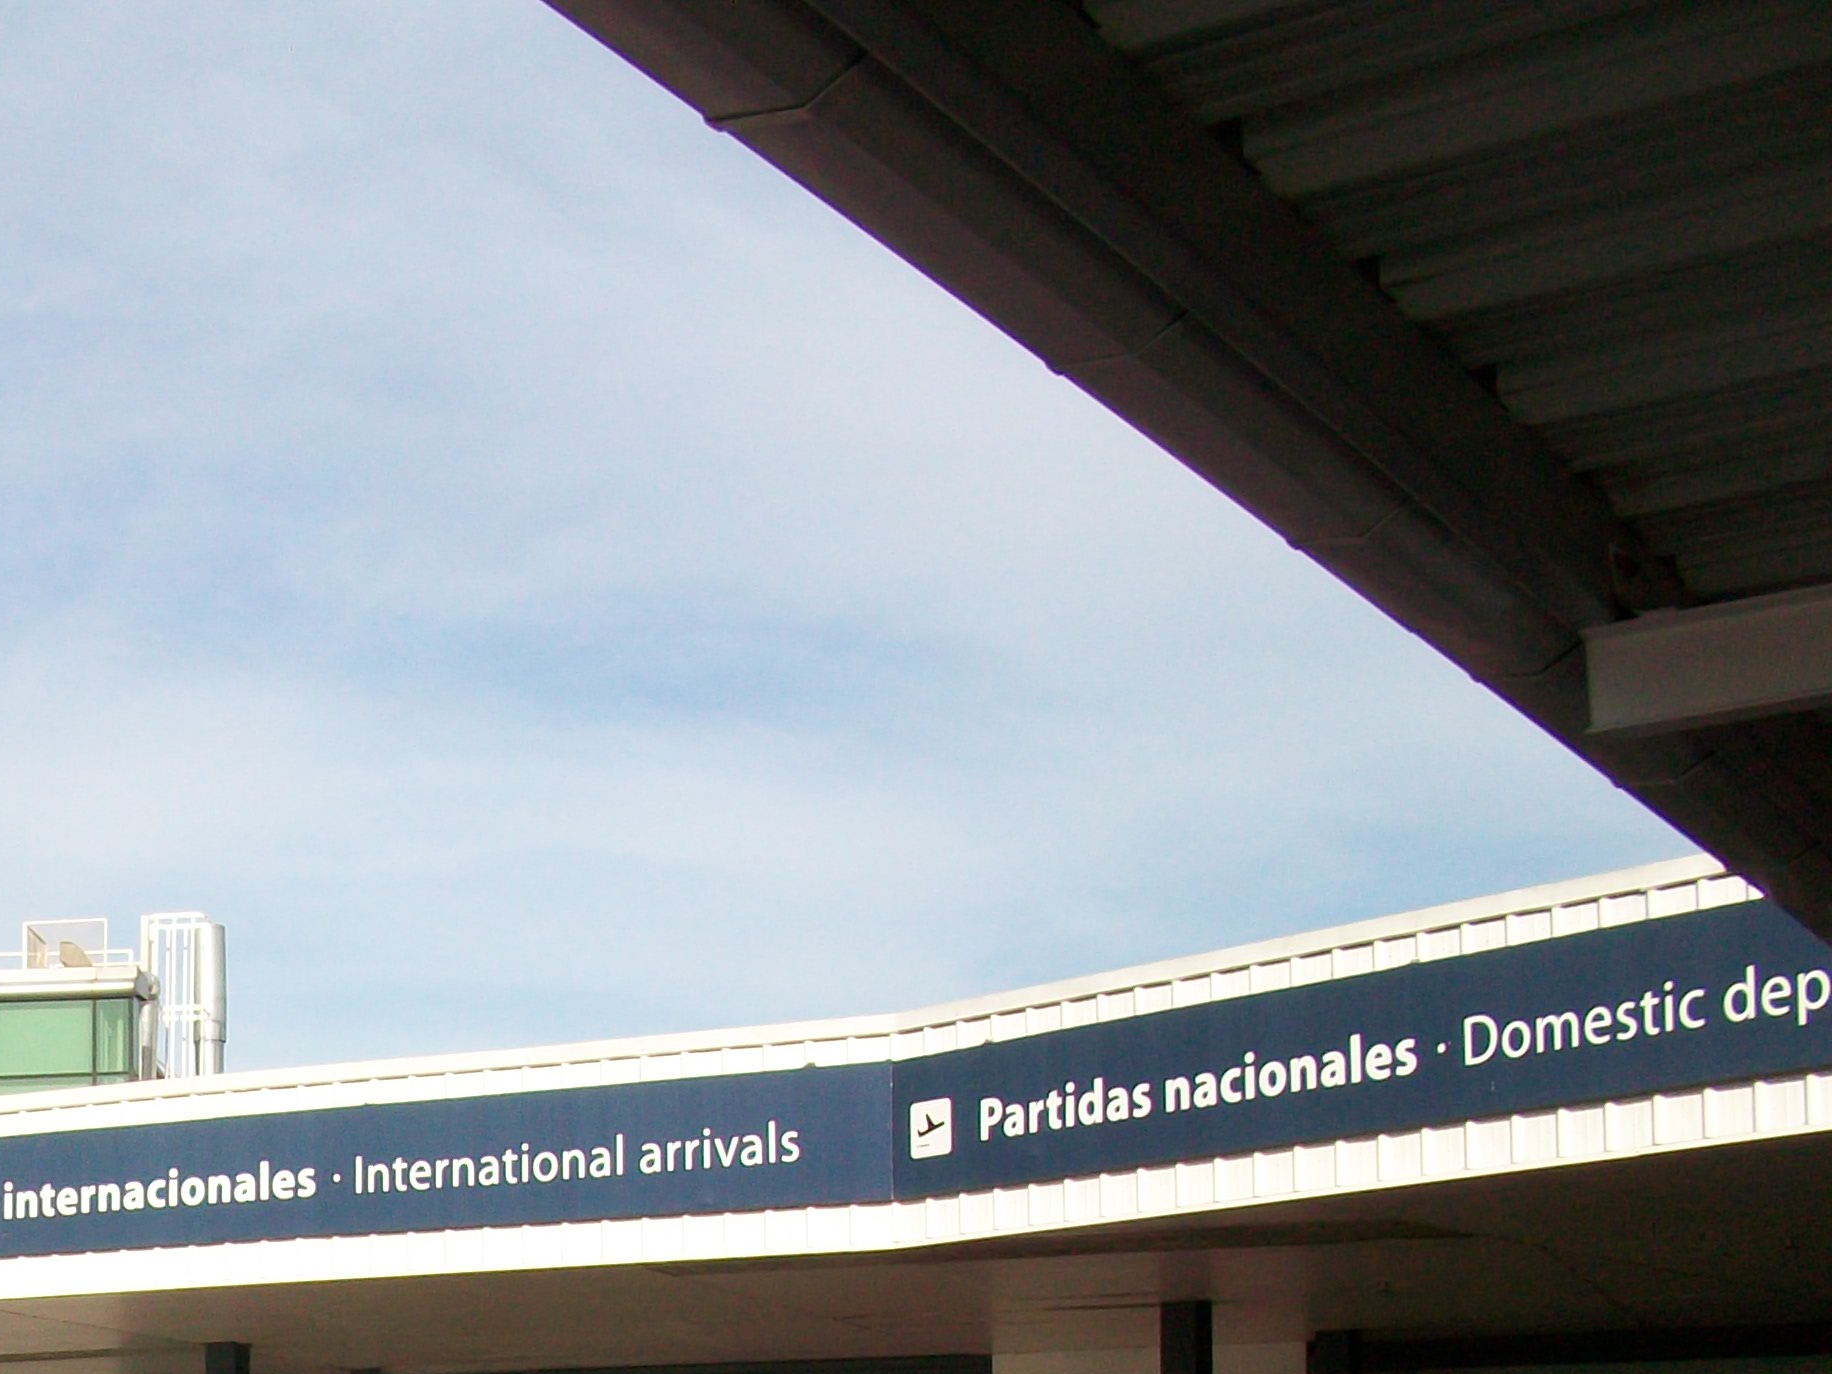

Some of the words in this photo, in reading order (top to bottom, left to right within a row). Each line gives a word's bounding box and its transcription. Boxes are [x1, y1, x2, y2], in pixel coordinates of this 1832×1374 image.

[979, 1076, 1153, 1142] Partidas
[1165, 1033, 1419, 1113] nacionales
[1463, 980, 1706, 1066] Domestic
[1723, 964, 1832, 1026] dep
[3, 1160, 317, 1221] internacionales
[355, 1133, 624, 1195] International
[638, 1120, 800, 1176] arrivals
